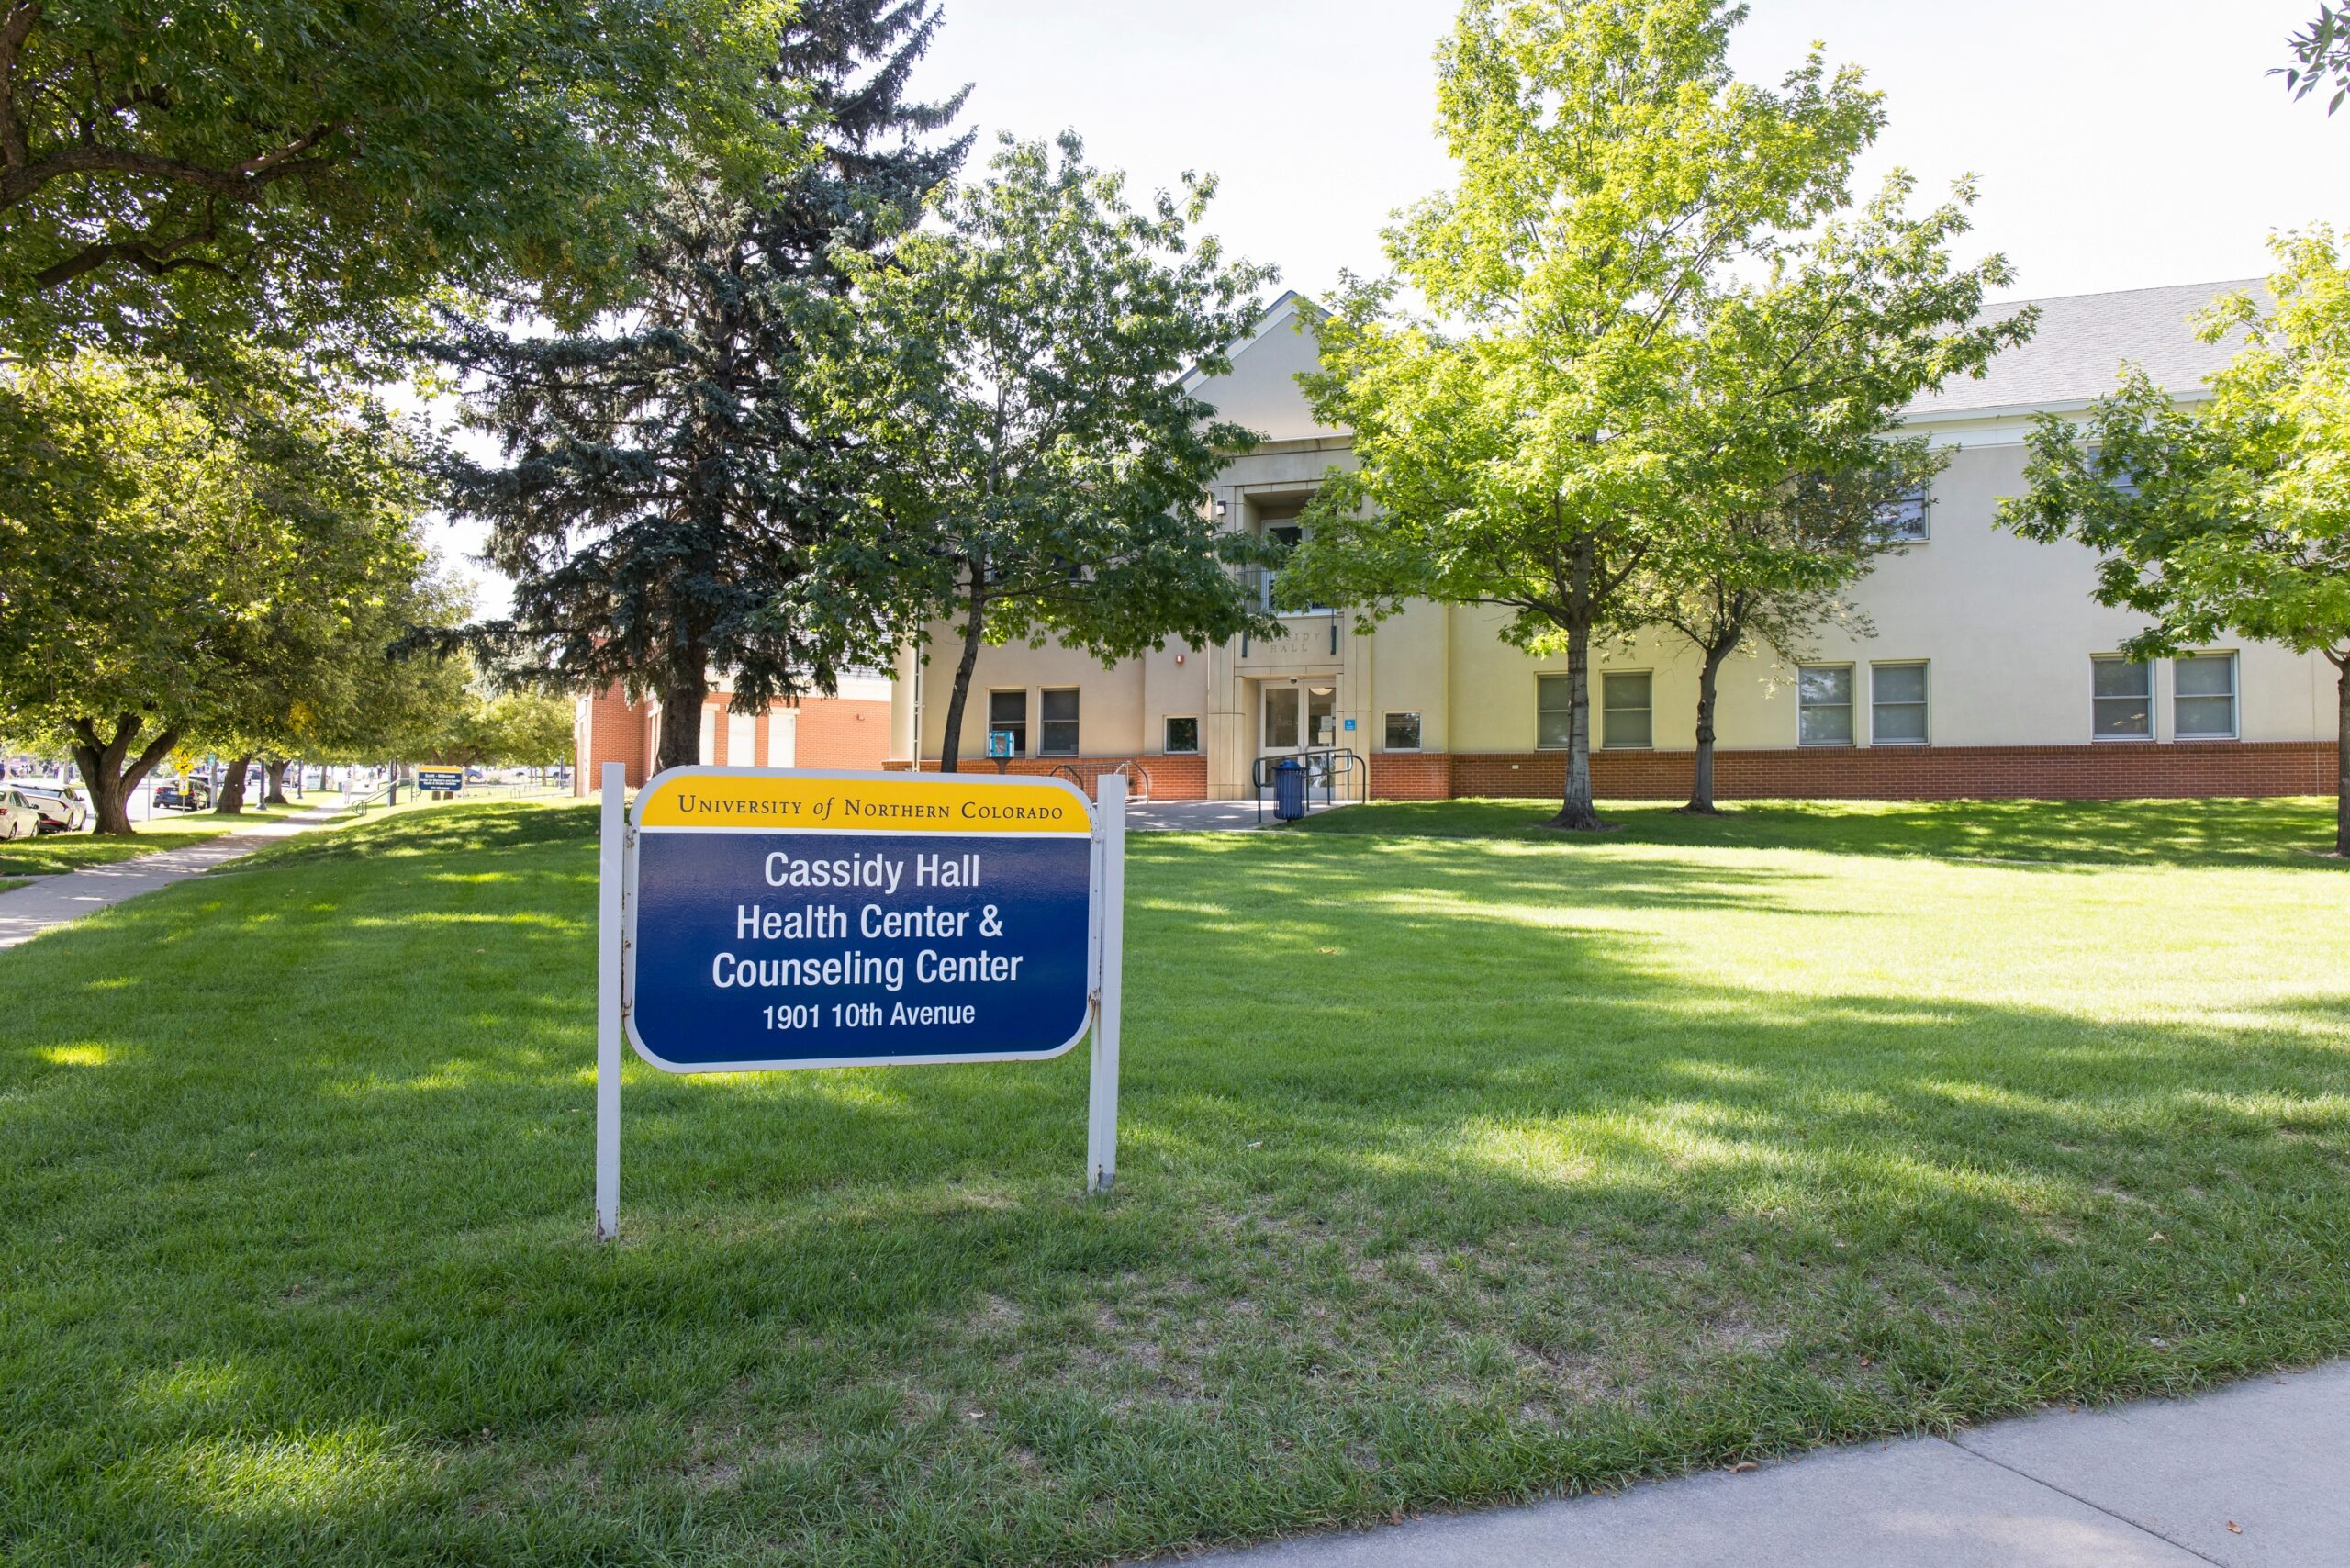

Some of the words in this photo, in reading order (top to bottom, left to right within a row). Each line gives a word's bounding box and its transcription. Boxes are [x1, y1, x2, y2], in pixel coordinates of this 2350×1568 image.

[1270, 644, 1308, 654] HALL
[678, 794, 801, 814] UNIVERSITY
[813, 797, 835, 821] of
[845, 799, 950, 818] NORTHERN
[961, 801, 1063, 820] COLORADO
[765, 851, 904, 895] Cassidy
[916, 853, 979, 888] Hall
[737, 904, 847, 940] Health
[860, 903, 970, 938] Center
[979, 904, 1003, 937] &
[712, 950, 904, 991] Counseling
[916, 949, 1024, 983] Center
[763, 1004, 819, 1030] 1901
[832, 1002, 883, 1027] 10th
[890, 1002, 975, 1025] Avenue
